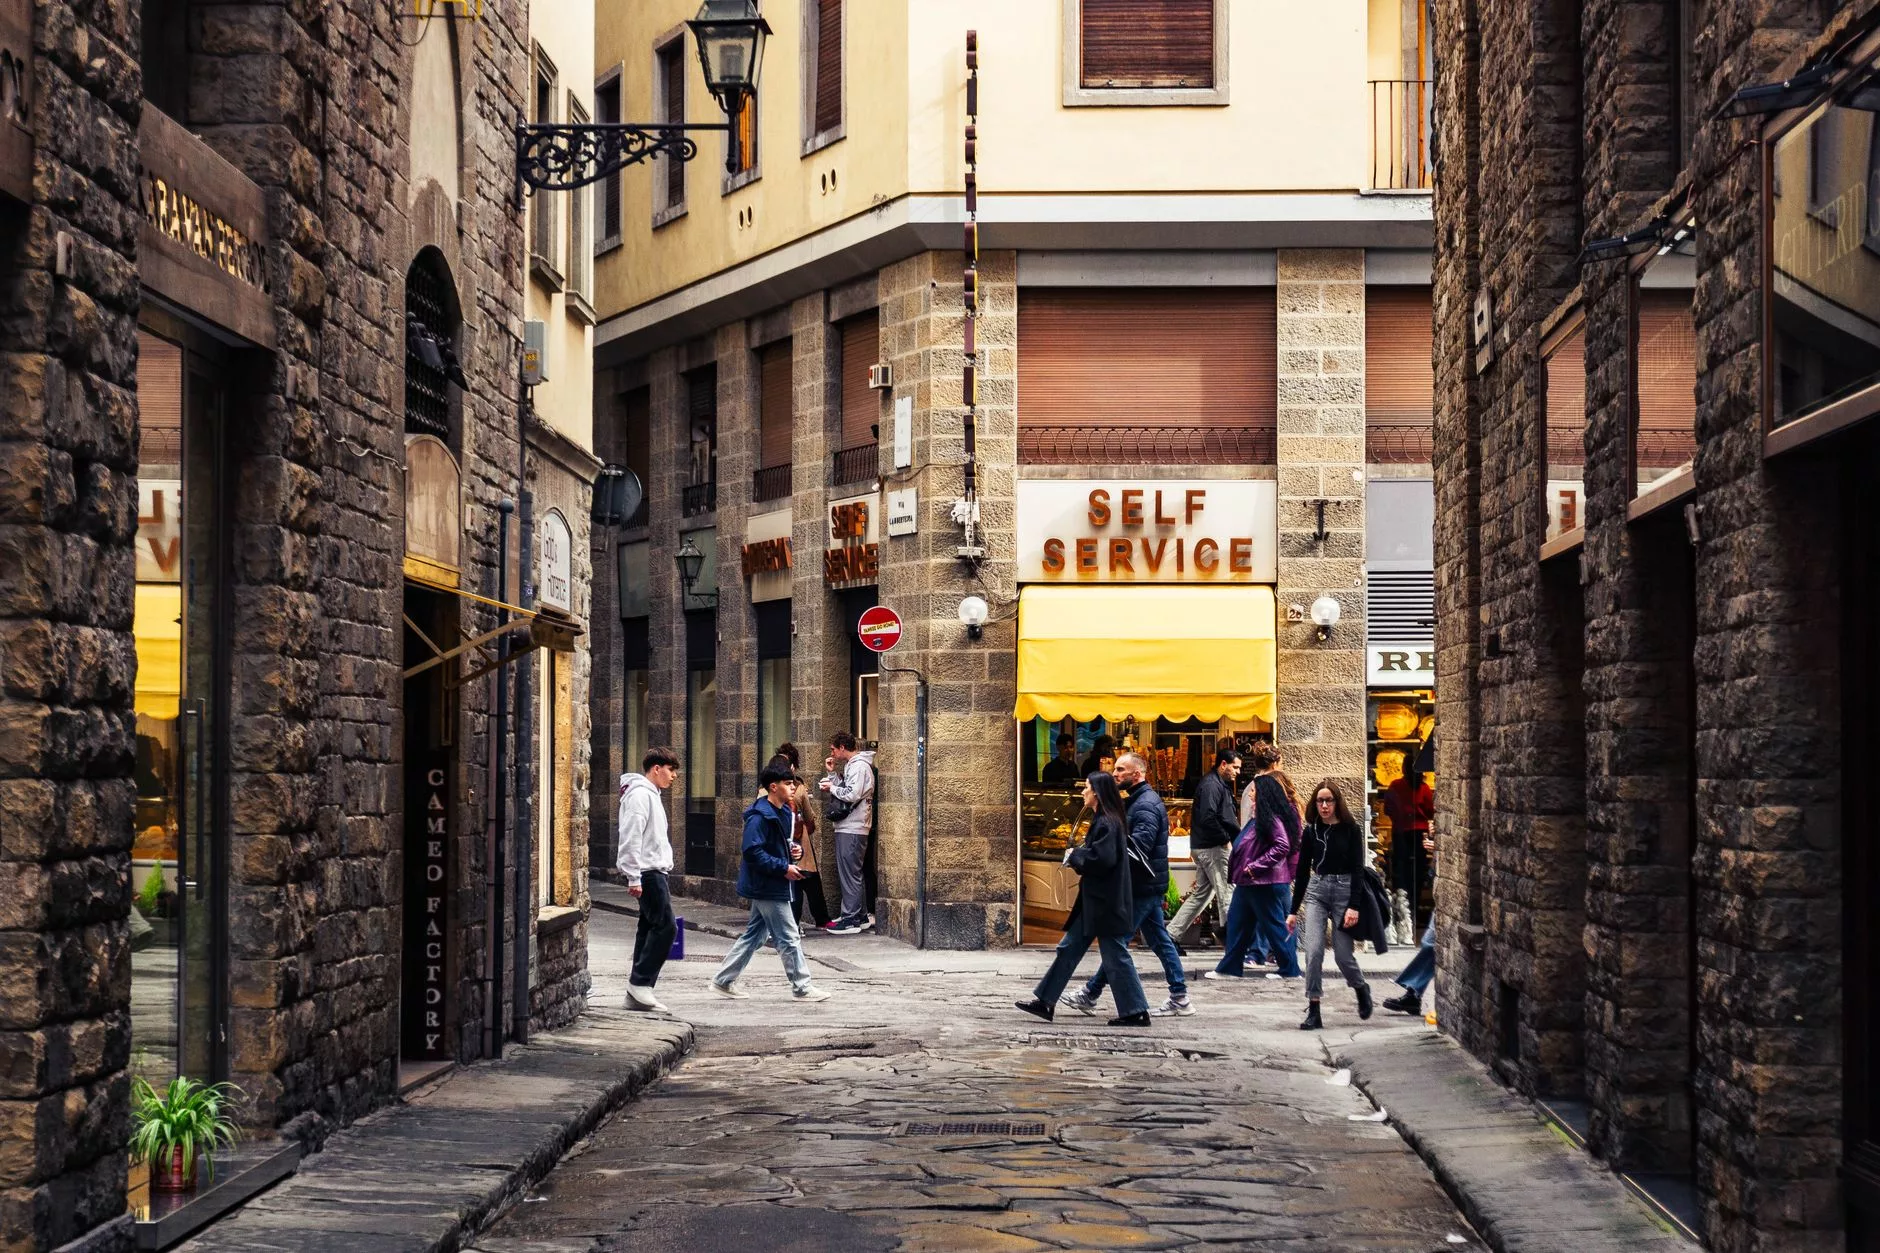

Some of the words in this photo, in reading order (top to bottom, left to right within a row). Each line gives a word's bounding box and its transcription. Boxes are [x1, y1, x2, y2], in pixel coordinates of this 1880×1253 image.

[831, 502, 866, 539] SELF
[1087, 488, 1207, 527] SELF
[1041, 537, 1254, 574] SERVICE
[426, 769, 446, 882] CAMEO
[425, 896, 442, 1051] FACTORY
